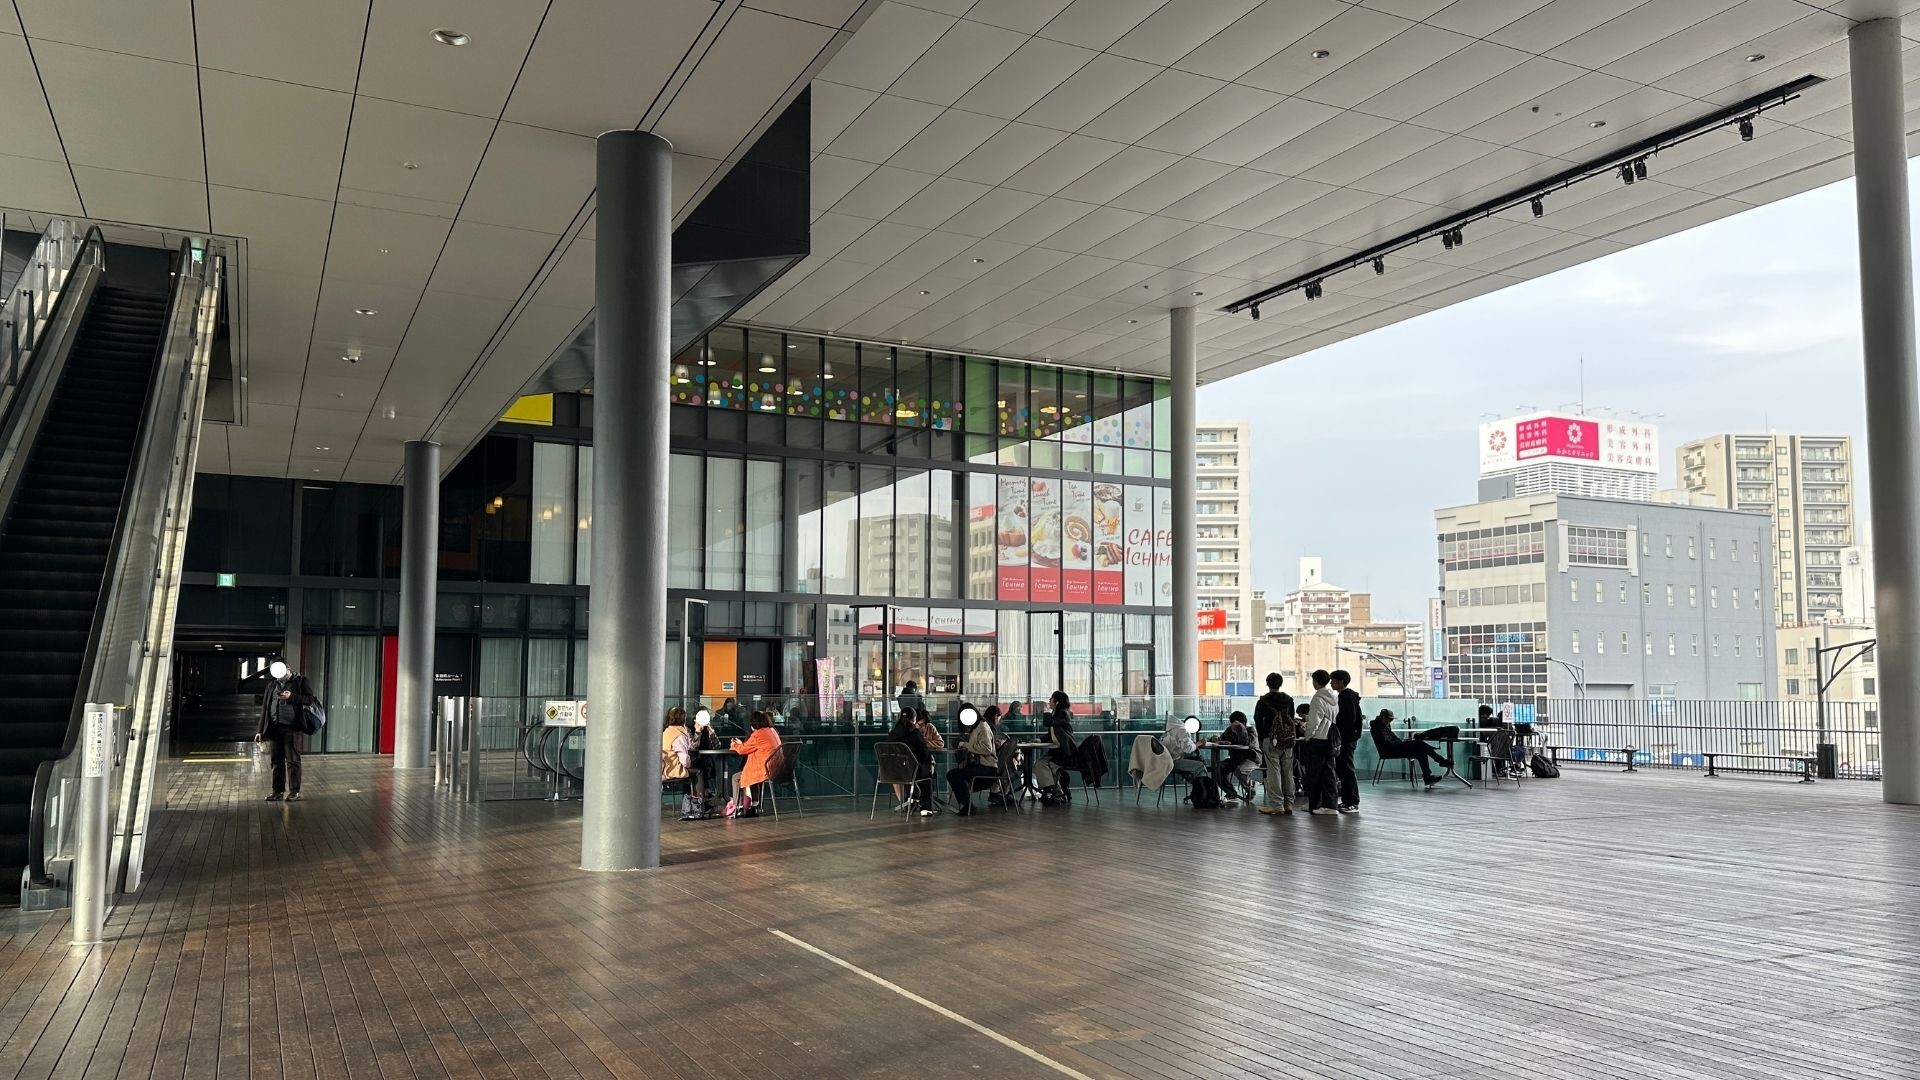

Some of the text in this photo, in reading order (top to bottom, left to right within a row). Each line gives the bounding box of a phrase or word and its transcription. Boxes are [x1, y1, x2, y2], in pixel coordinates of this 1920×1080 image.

[1606, 423, 1651, 438] 形成外科
[1607, 438, 1651, 453] 美容外科
[1126, 547, 1172, 567] ICHIM
